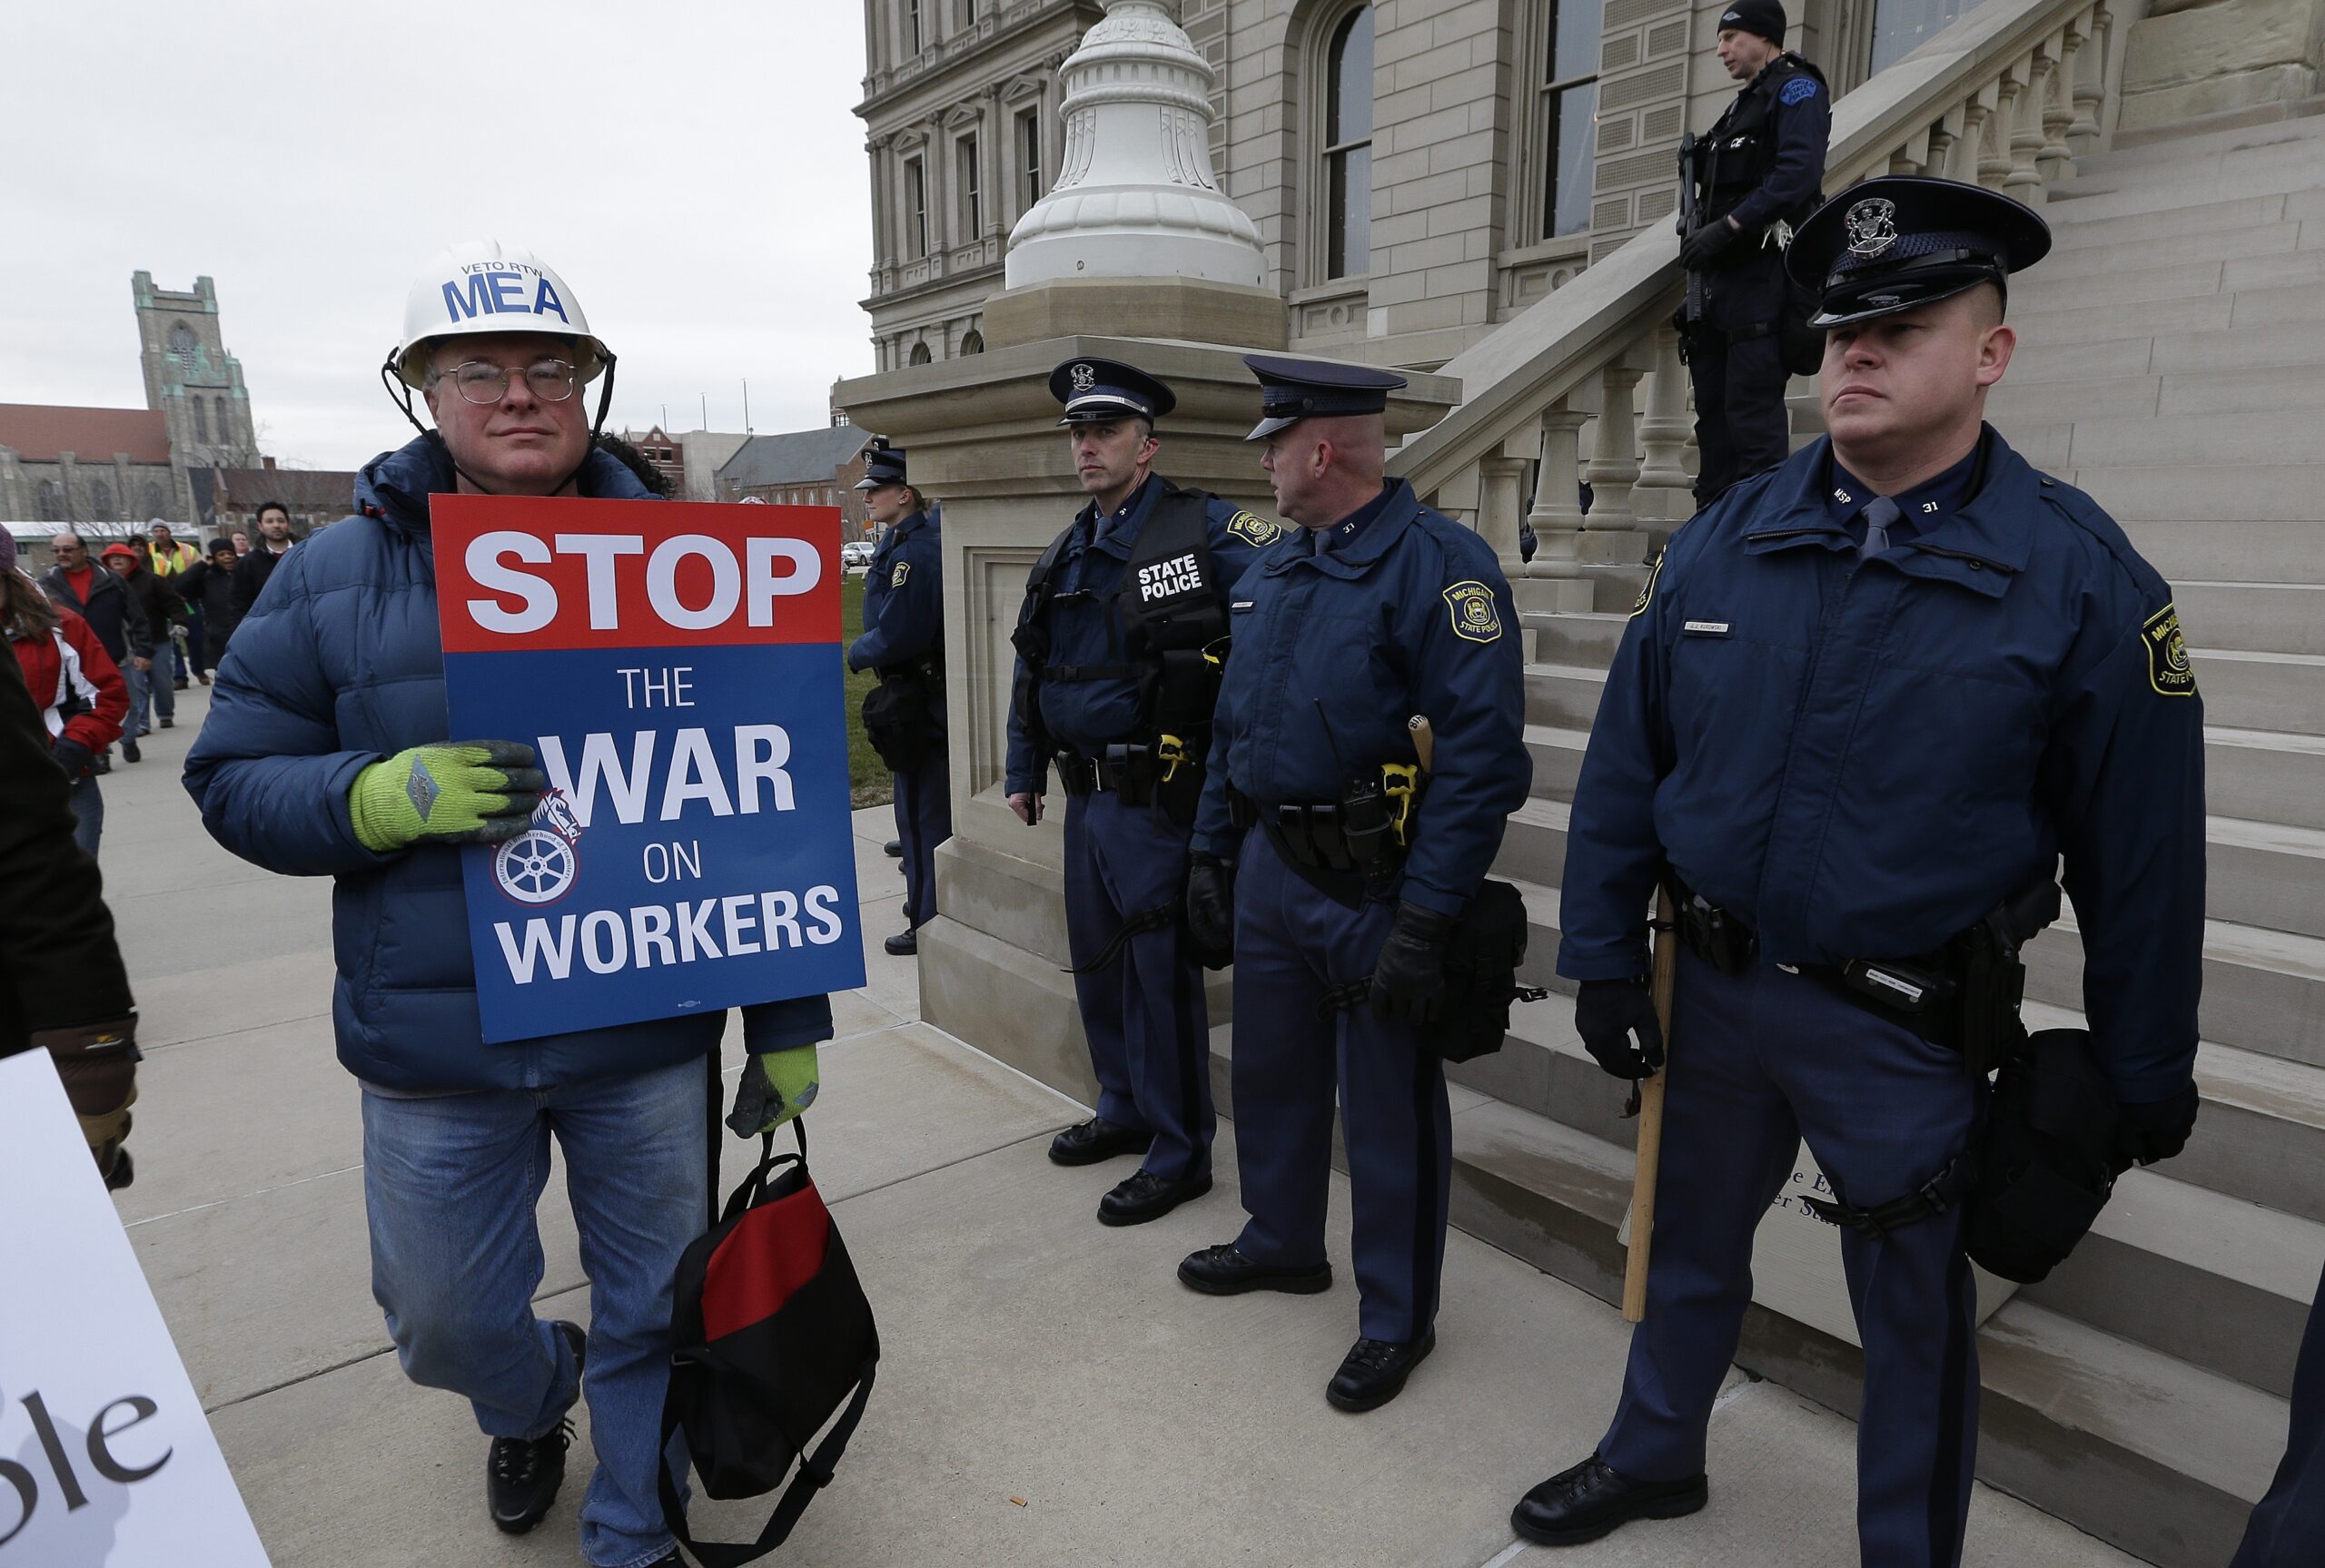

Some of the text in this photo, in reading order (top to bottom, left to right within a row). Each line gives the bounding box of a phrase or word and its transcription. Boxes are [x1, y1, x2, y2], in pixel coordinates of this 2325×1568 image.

[460, 261, 543, 278] VETO RTW
[441, 272, 570, 324] MEA
[1834, 488, 1852, 504] MSP
[1922, 501, 1939, 513] 31
[464, 530, 822, 634] STOP
[1138, 553, 1198, 585] STATE
[1141, 571, 1202, 602] POLICE
[1459, 620, 1481, 633] STATE
[617, 667, 696, 708] THE
[537, 724, 796, 828] WAR
[643, 841, 702, 884] ON
[493, 884, 843, 985] WORKERS
